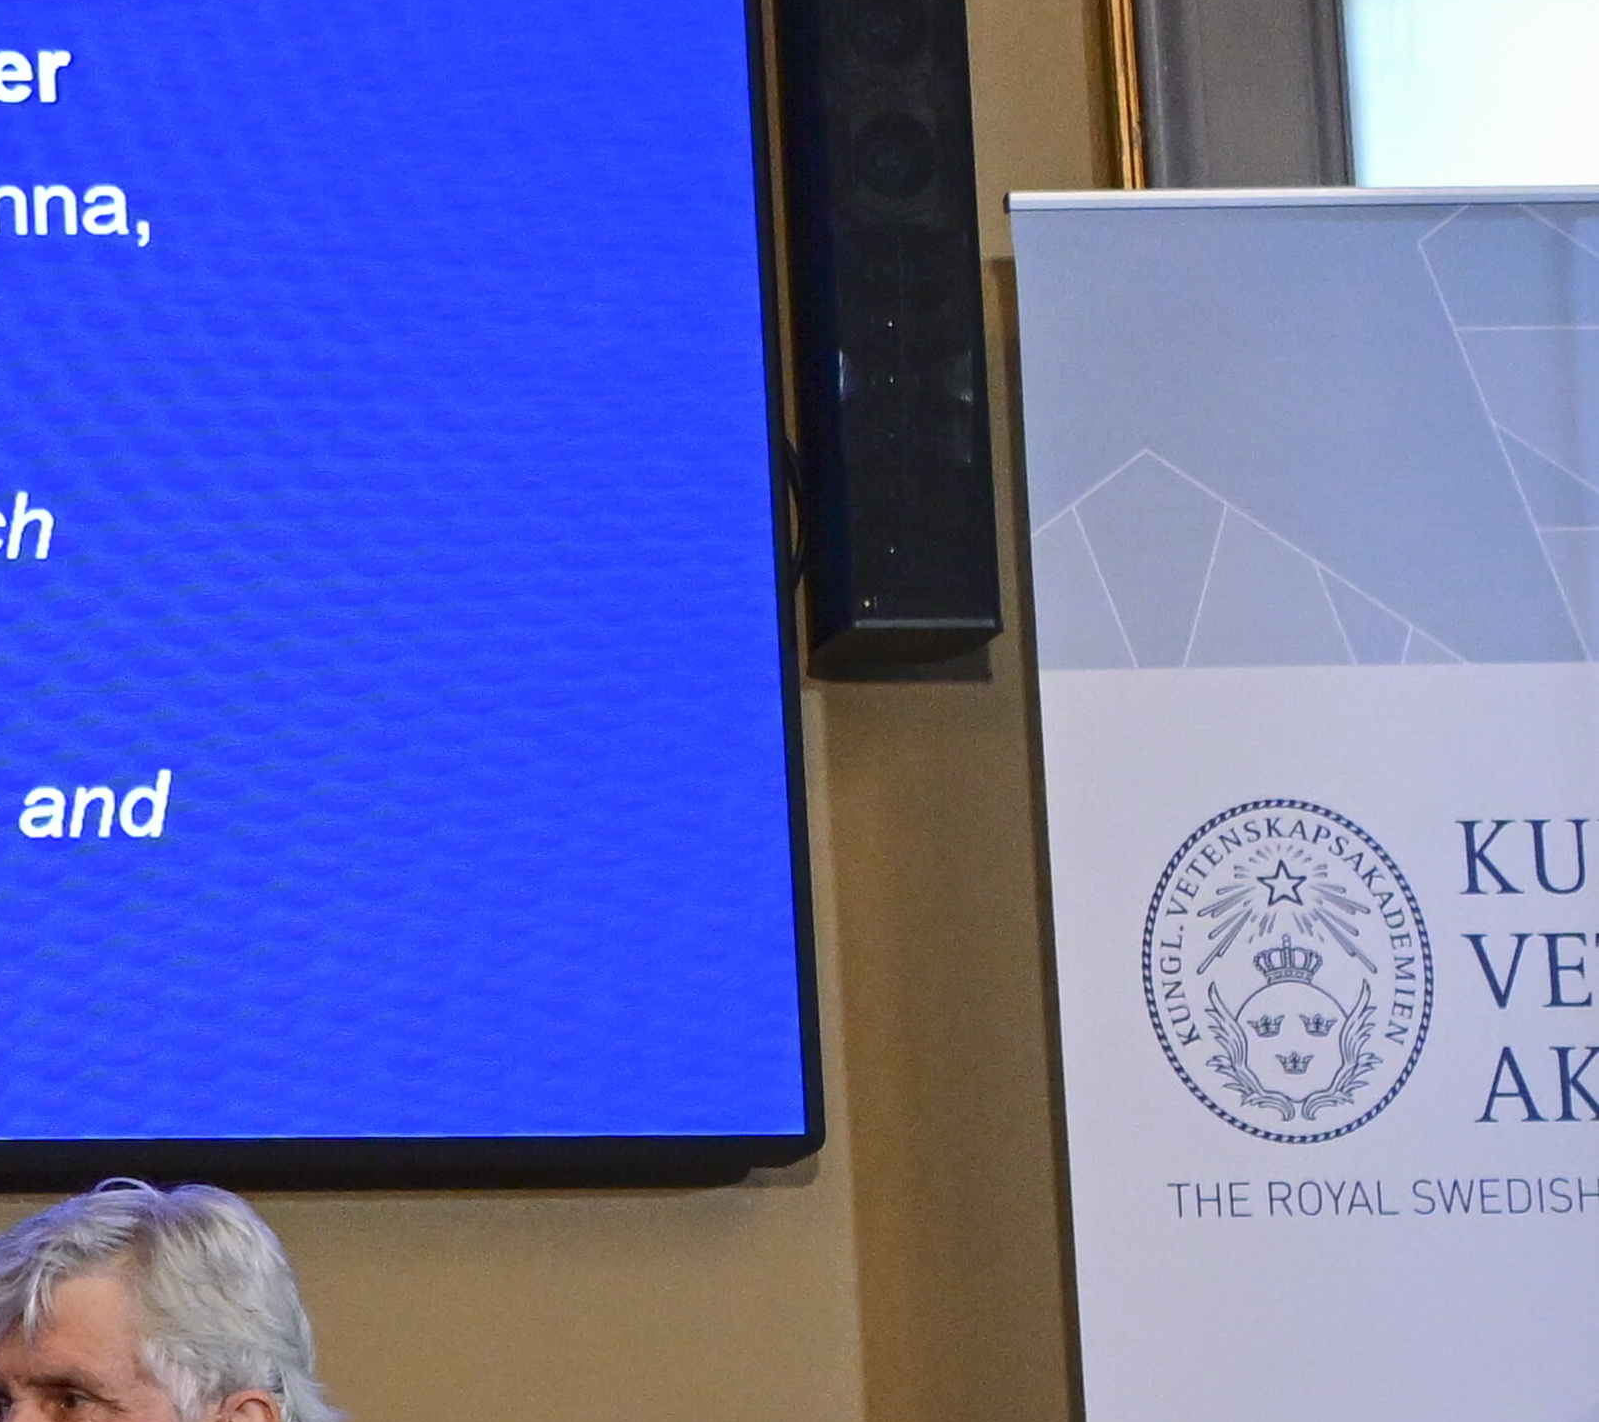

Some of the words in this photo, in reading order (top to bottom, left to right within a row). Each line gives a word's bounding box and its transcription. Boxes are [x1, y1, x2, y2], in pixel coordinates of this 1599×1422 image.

[17, 768, 173, 839] and
[1460, 931, 1599, 1011] VE
[1473, 1045, 1599, 1124] AK
[1166, 1180, 1253, 1220] THE
[1266, 1178, 1401, 1218] ROYAL
[1411, 1176, 1599, 1216] SWEDISH
